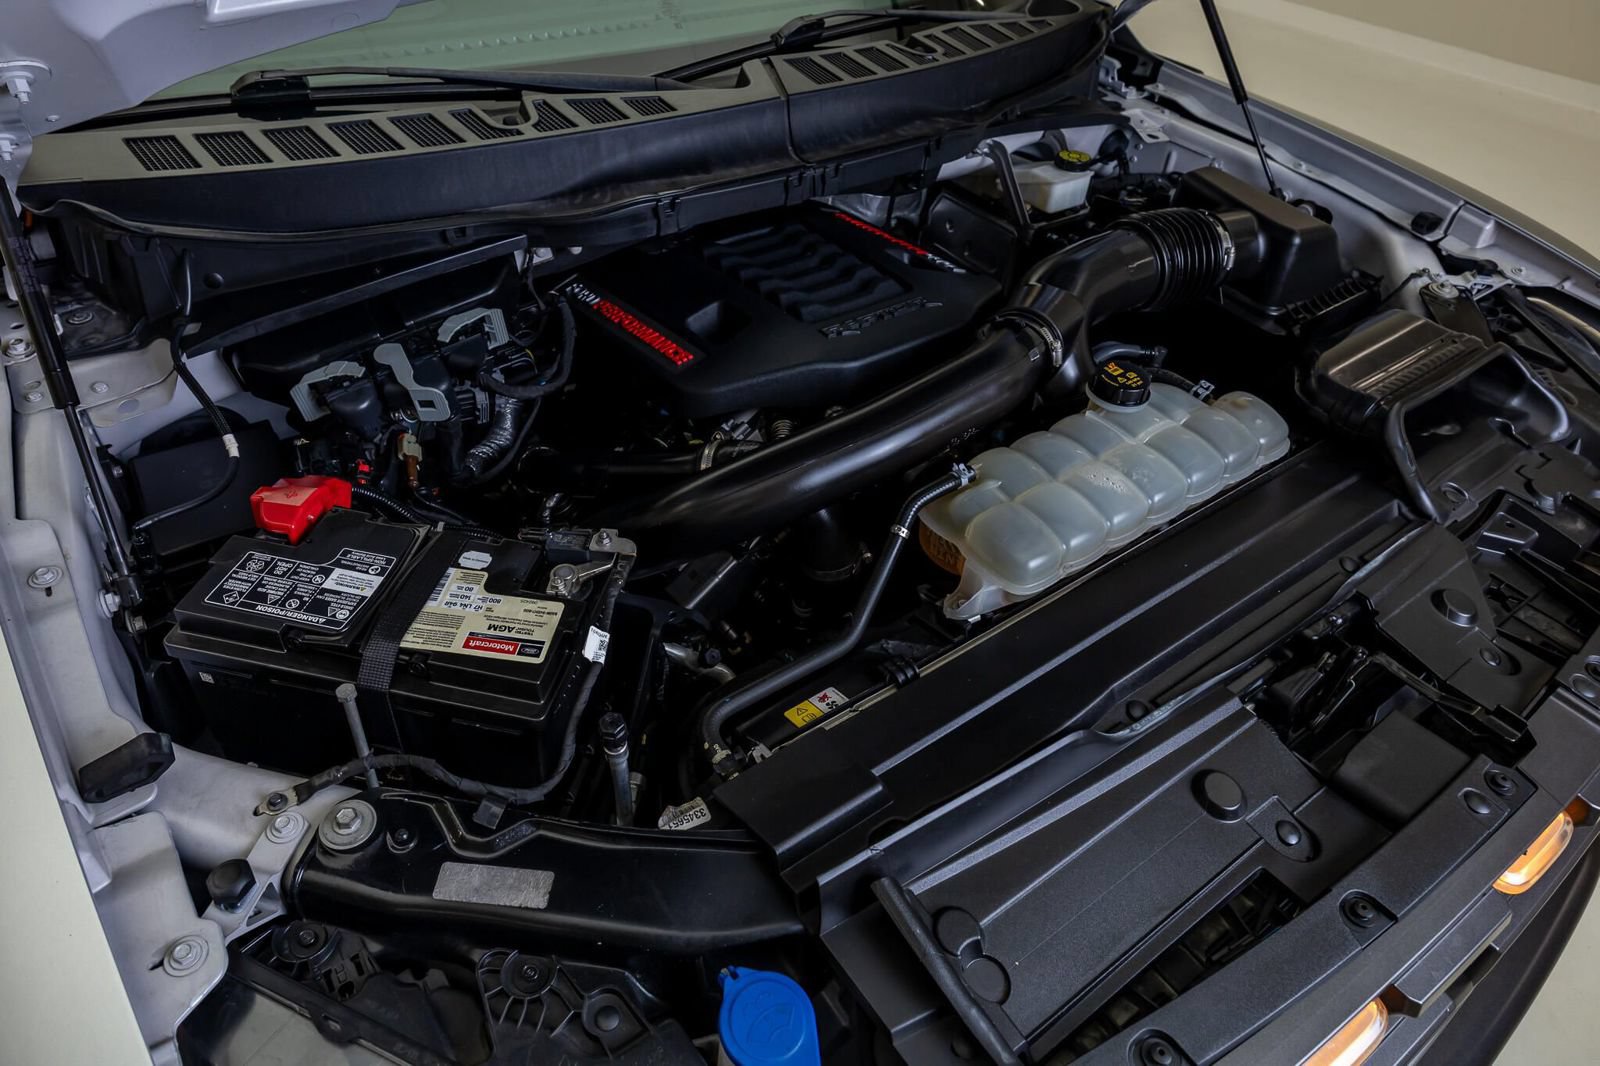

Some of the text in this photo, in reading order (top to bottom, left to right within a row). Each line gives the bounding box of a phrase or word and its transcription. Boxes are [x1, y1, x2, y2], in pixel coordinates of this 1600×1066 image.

[254, 604, 320, 622] DANGER/POISON
[488, 624, 516, 633] AGM
[468, 639, 514, 651] Motorcraft
